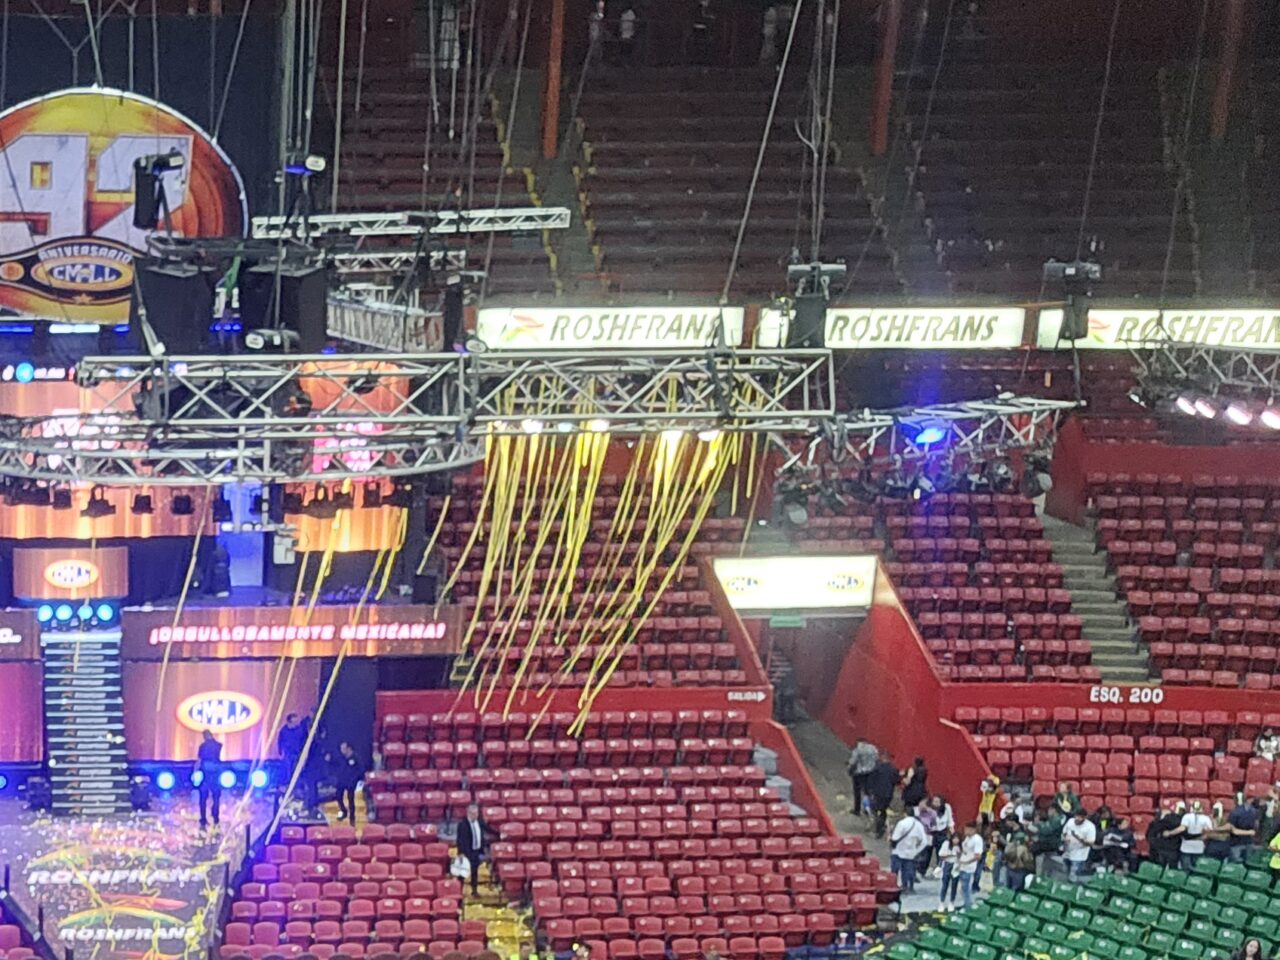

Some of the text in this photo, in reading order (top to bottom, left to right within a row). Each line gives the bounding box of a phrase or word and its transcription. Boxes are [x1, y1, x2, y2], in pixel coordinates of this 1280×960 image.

[38, 245, 133, 264] ANIVERSARIO
[52, 264, 118, 284] CMLL
[827, 315, 999, 342] ROSHFRANS
[1115, 316, 1280, 344] ROSHFRAN
[1090, 686, 1164, 704] ESQ. 200
